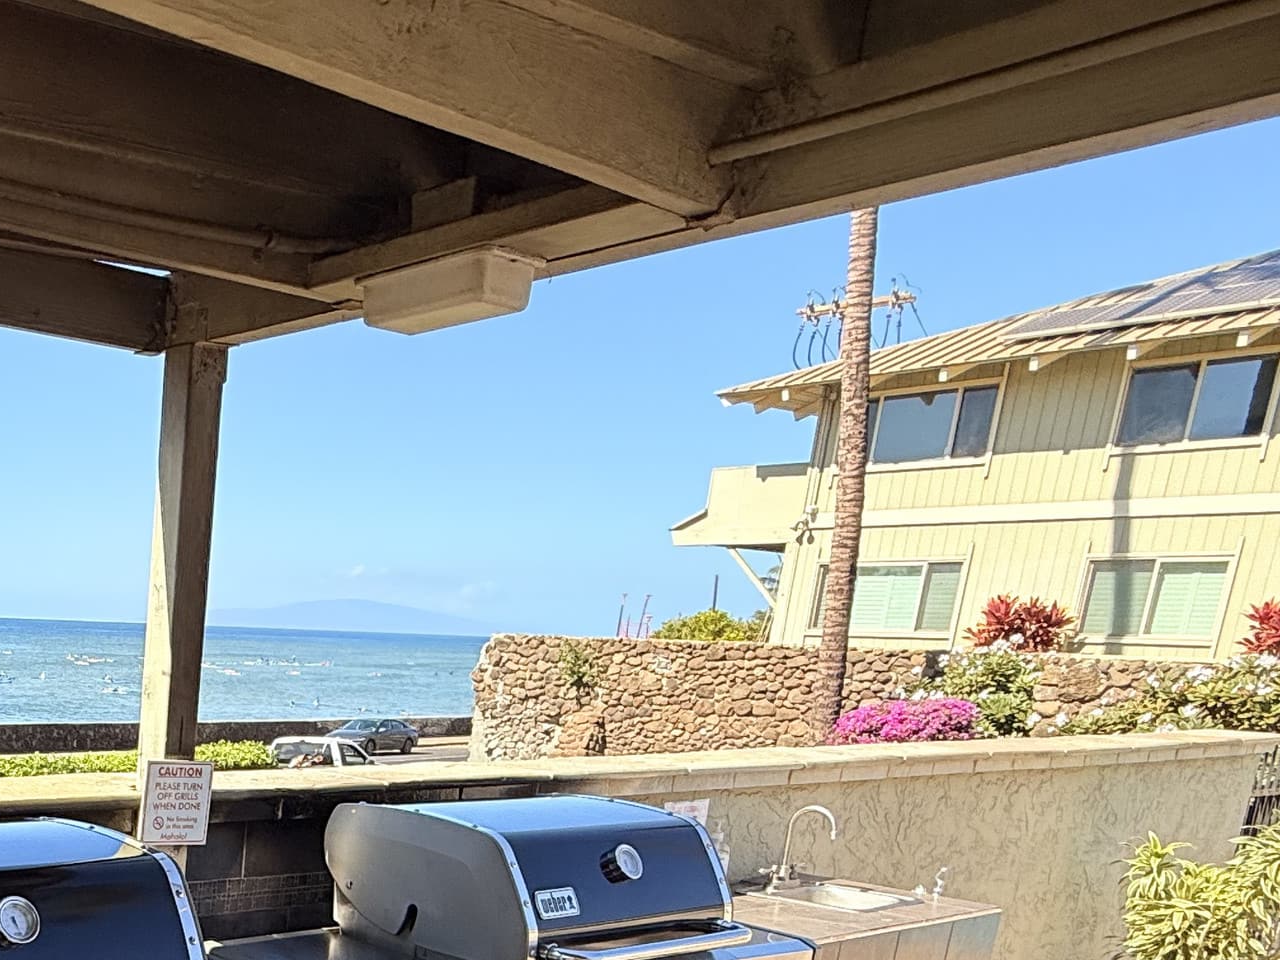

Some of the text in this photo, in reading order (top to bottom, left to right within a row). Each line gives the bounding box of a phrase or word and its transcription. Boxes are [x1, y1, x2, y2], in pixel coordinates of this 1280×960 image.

[158, 766, 203, 777] CAUTION
[155, 782, 203, 791] PLEASE TURN
[157, 792, 199, 800] OFF GRILLS
[153, 802, 201, 810] WHEN DONE
[539, 892, 568, 914] weber
